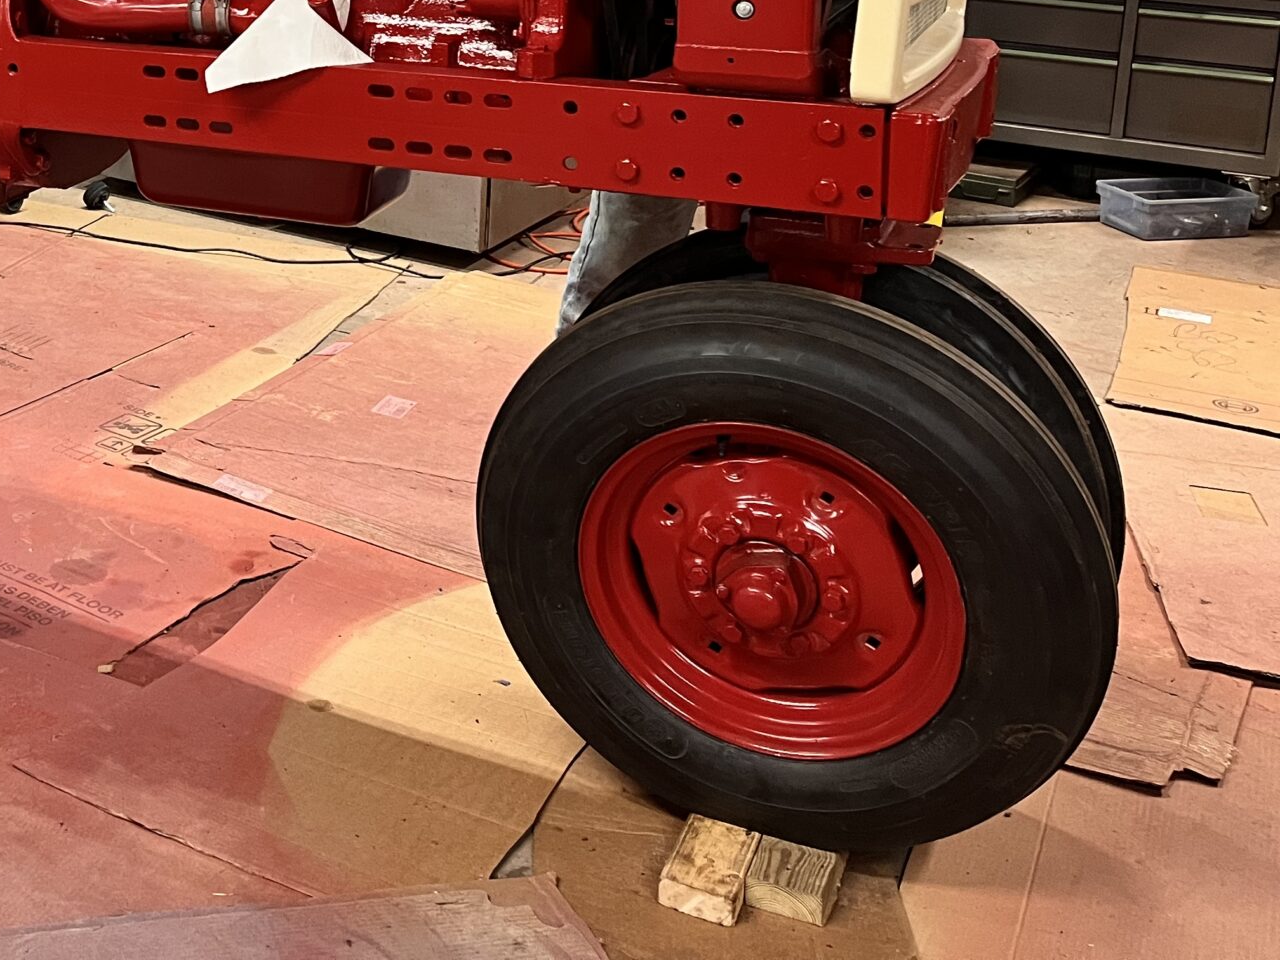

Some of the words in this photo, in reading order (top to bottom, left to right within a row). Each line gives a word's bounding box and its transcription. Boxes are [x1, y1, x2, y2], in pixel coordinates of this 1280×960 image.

[123, 405, 155, 418] SIDE
[16, 591, 72, 619] DEBEN
[23, 572, 48, 585] BE
[44, 581, 71, 593] AT
[67, 591, 124, 620] FLOOR
[13, 605, 53, 626] PISO
